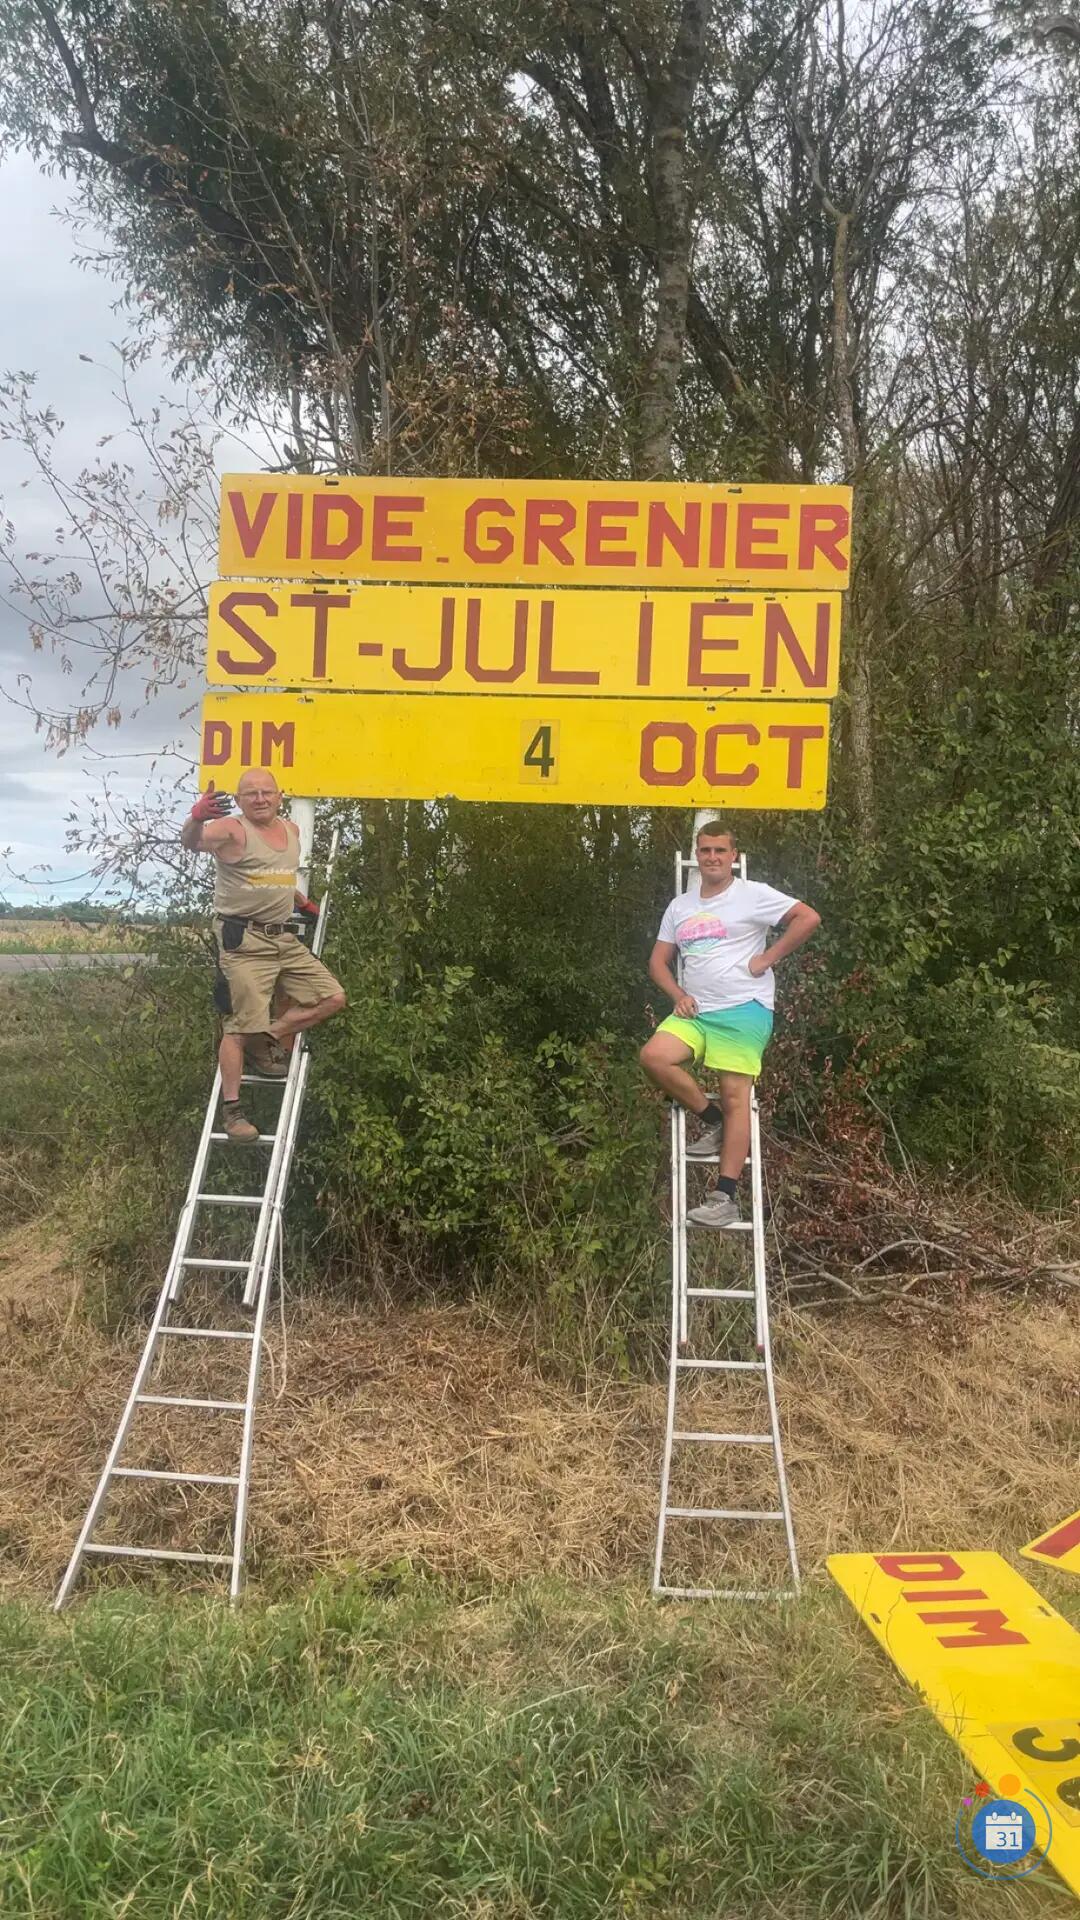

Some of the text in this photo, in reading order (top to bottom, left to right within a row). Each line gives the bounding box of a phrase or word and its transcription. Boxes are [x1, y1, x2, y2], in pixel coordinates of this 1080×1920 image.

[216, 592, 831, 688] ST-JULIEN
[202, 720, 824, 789] DIM 4 OCT
[873, 1554, 1031, 1649] DIM
